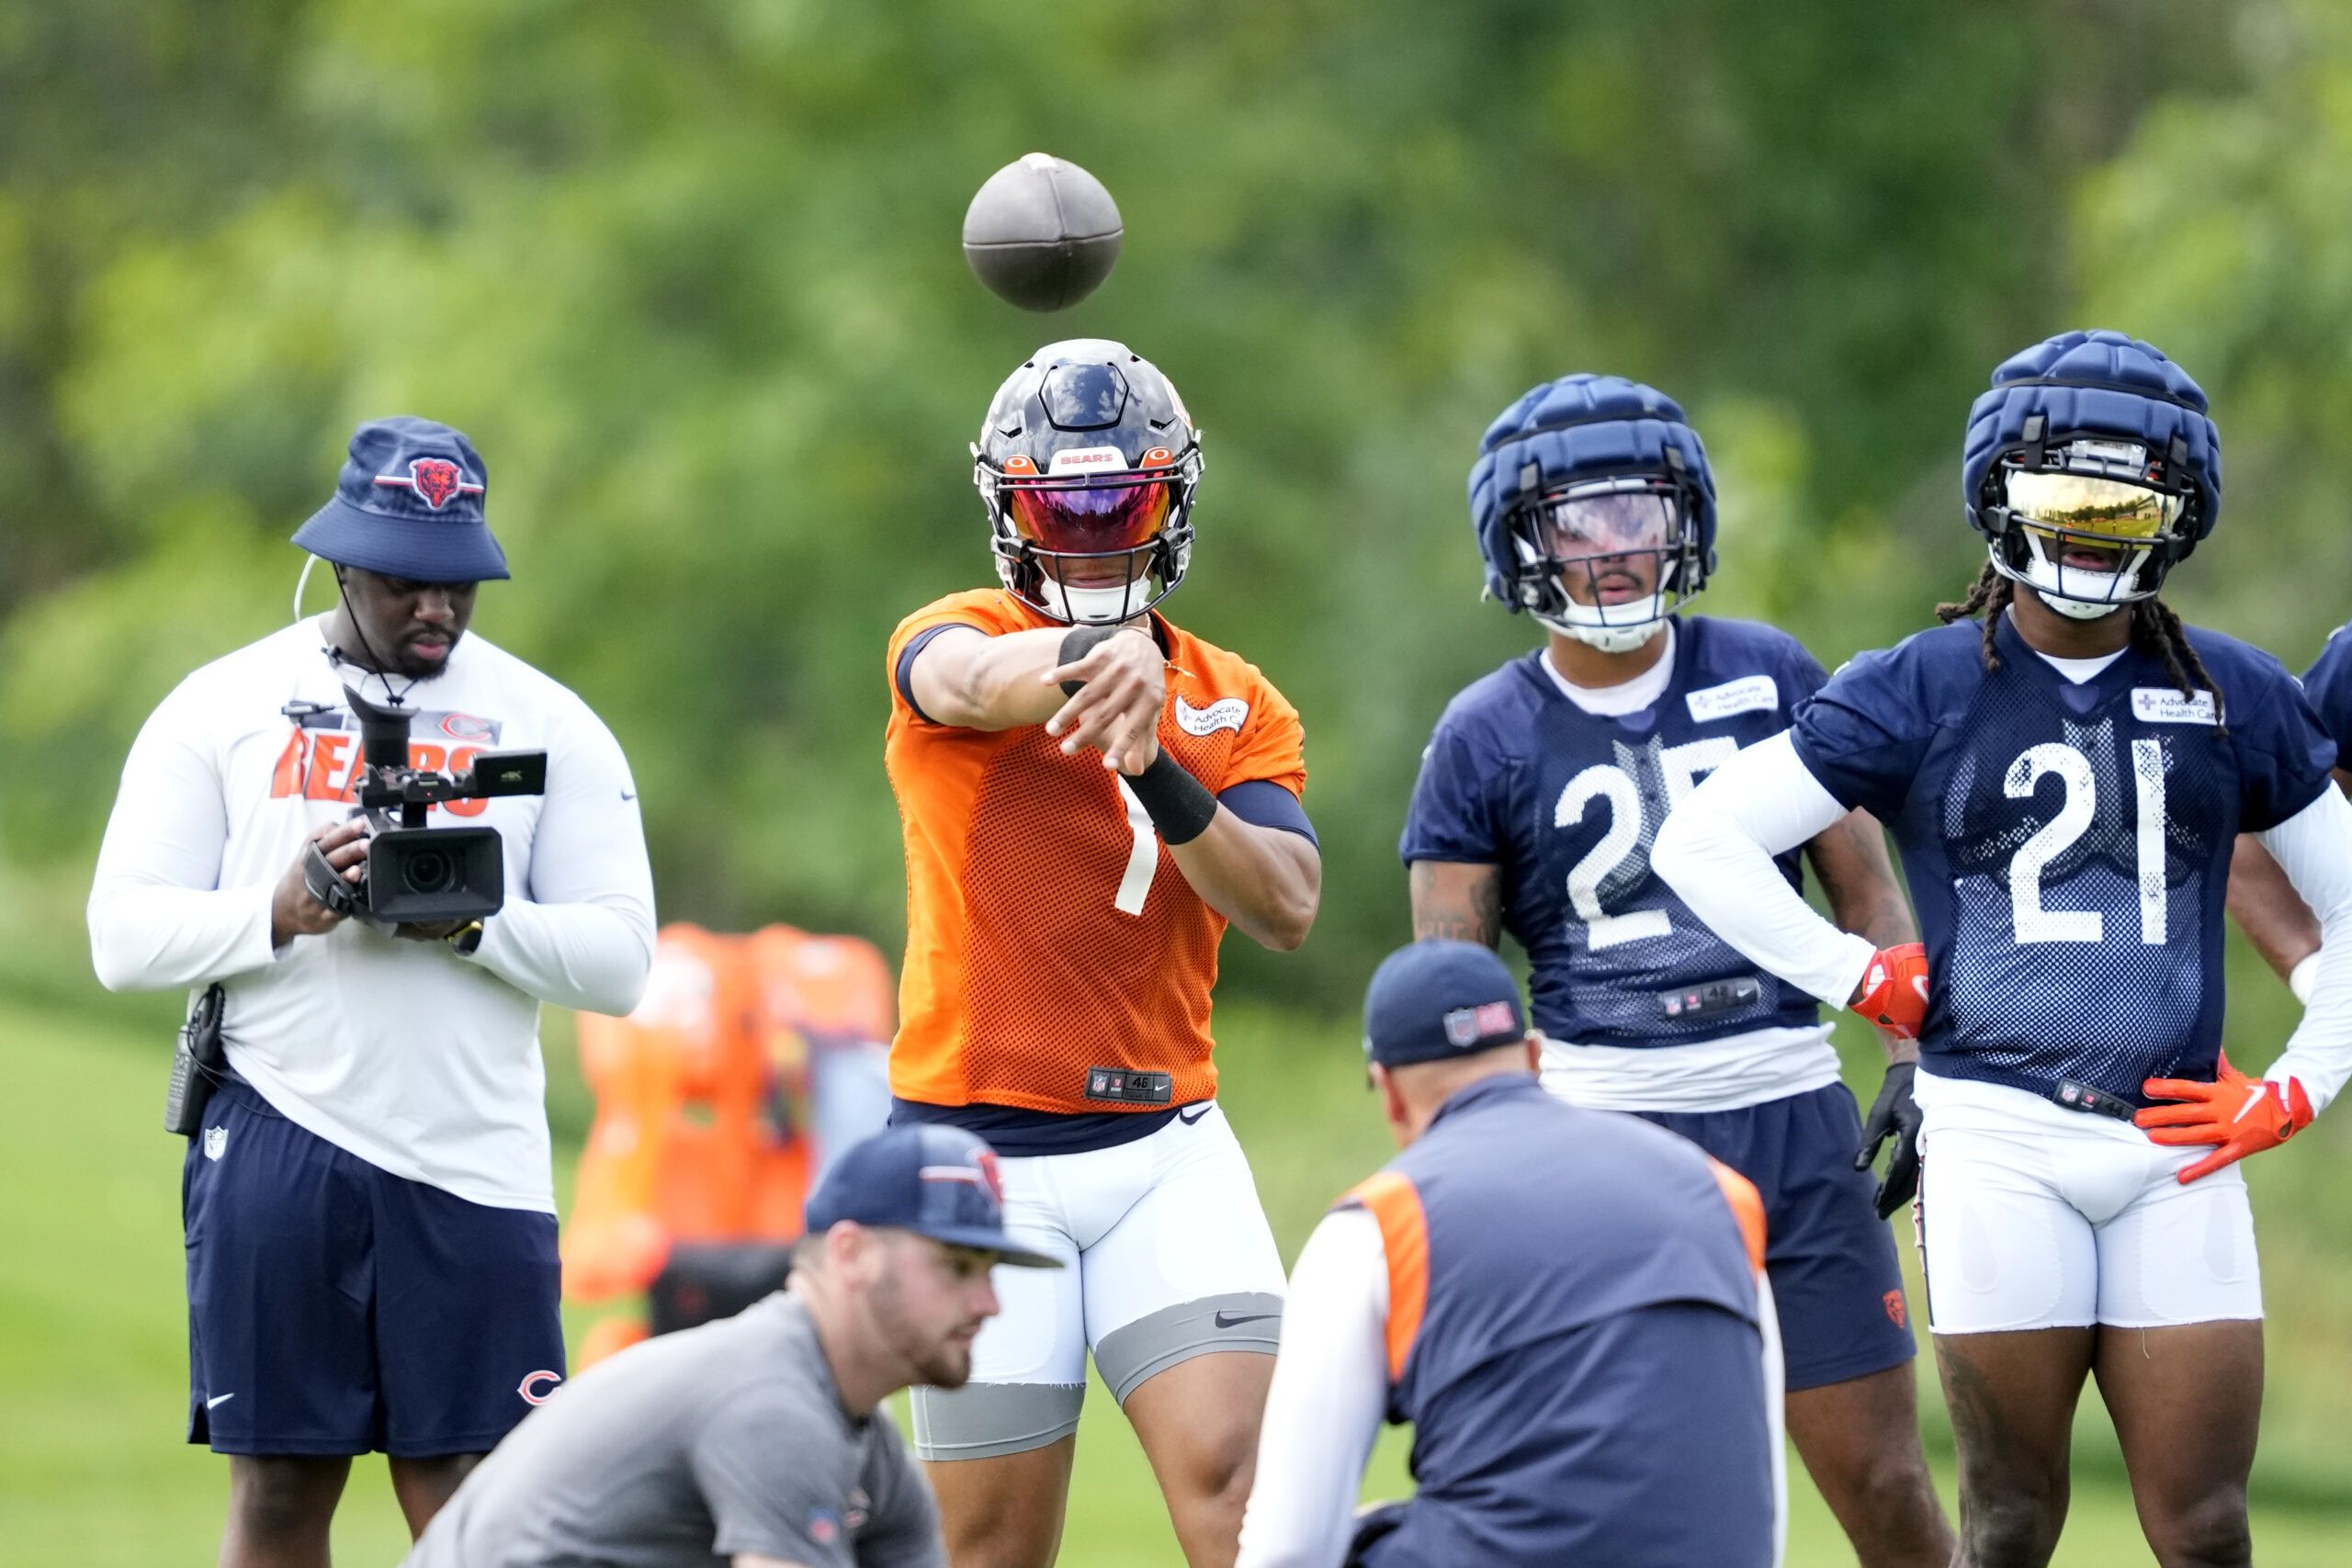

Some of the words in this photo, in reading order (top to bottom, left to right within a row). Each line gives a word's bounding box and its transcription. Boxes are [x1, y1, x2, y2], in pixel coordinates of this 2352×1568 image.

[1060, 454, 1114, 465] BEARS
[1194, 705, 1241, 723] Advocate
[2160, 709, 2195, 718] Health
[2197, 709, 2215, 719] Car
[1194, 716, 1227, 732] Health
[2003, 739, 2167, 945] 21
